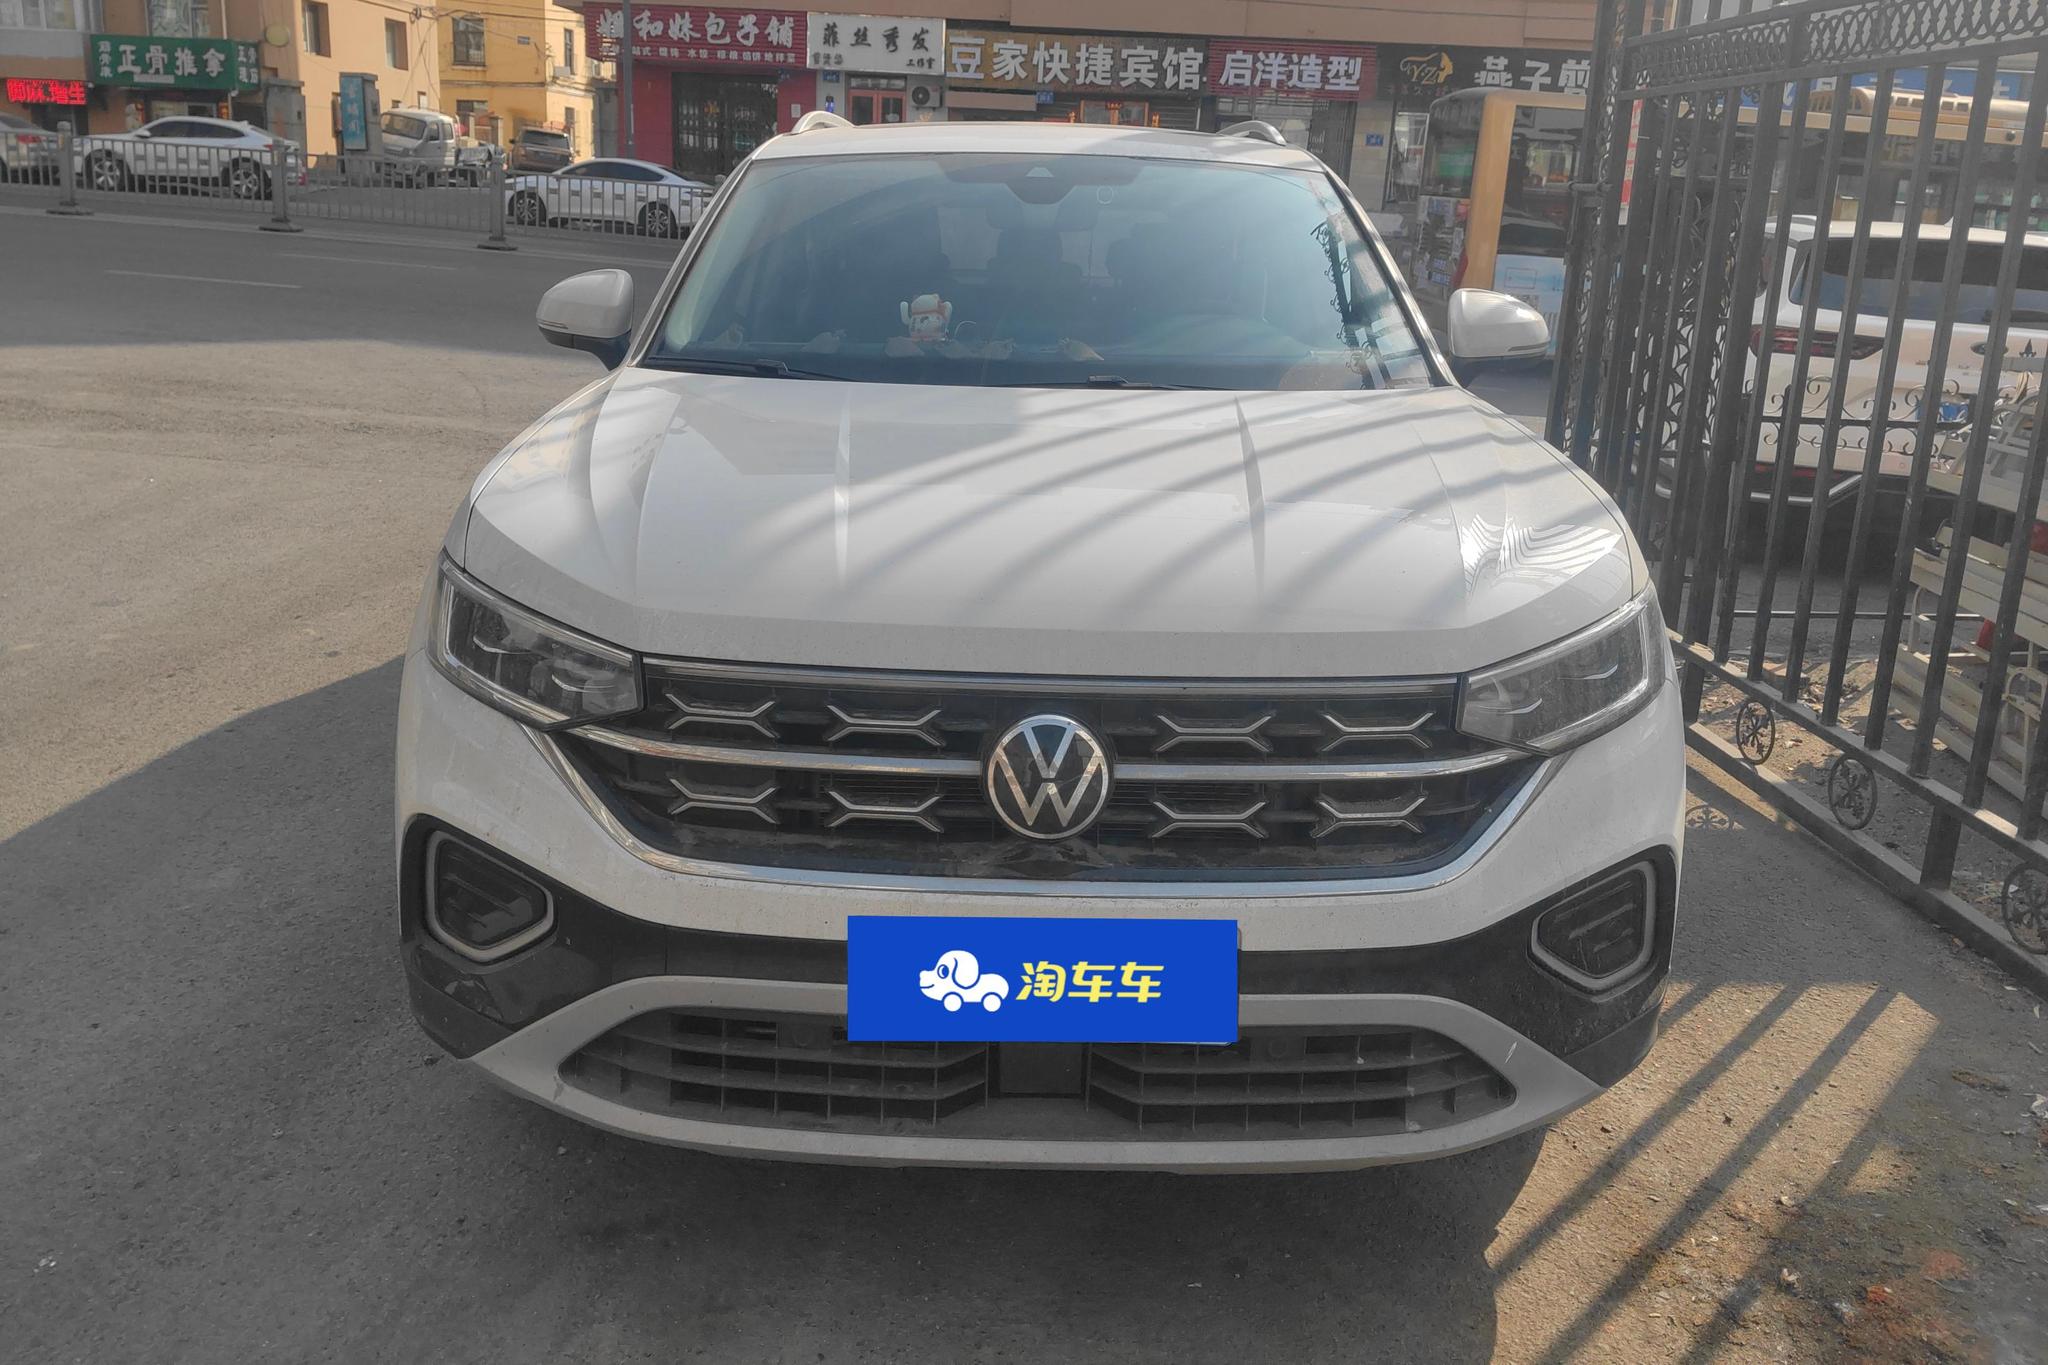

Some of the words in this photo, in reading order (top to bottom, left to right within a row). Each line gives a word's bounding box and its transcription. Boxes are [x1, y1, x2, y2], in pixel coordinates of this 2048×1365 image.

[822, 21, 930, 53] 菲丝秀发
[117, 44, 227, 78] 正骨推拿
[905, 57, 936, 69] 工作室
[946, 36, 1204, 90] 豆家快捷宾馆
[1218, 50, 1363, 91] 启洋造型
